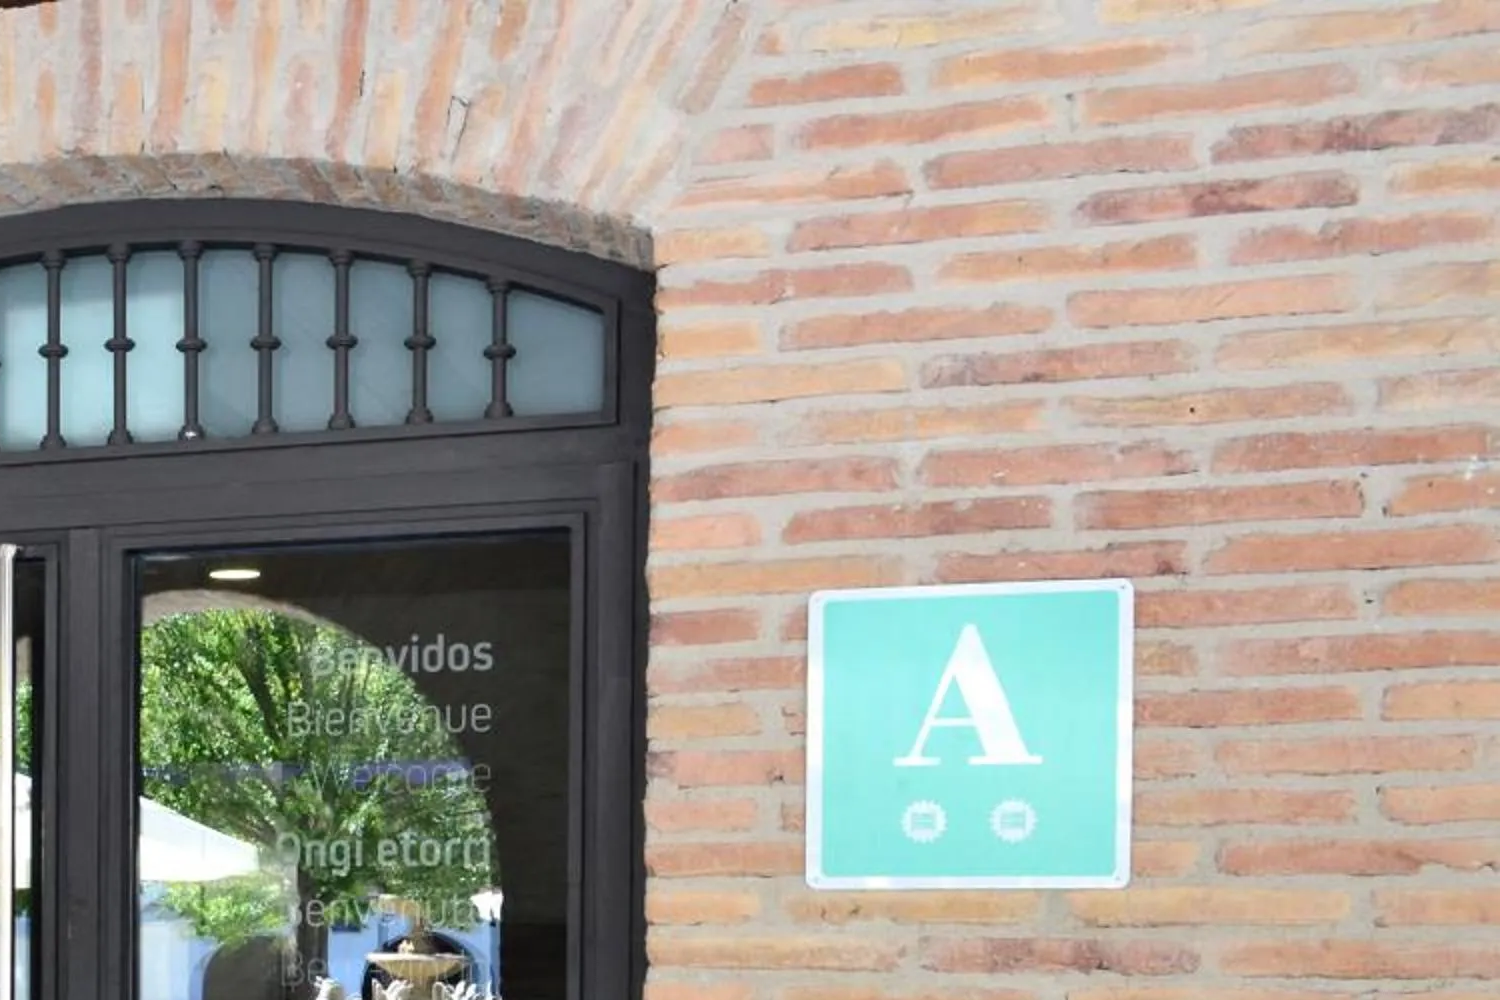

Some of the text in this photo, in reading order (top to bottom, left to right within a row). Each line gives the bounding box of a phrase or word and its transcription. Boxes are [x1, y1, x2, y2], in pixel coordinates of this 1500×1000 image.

[892, 622, 1044, 766] A
[286, 700, 493, 739] Bienvenue
[275, 830, 364, 877] Ongi
